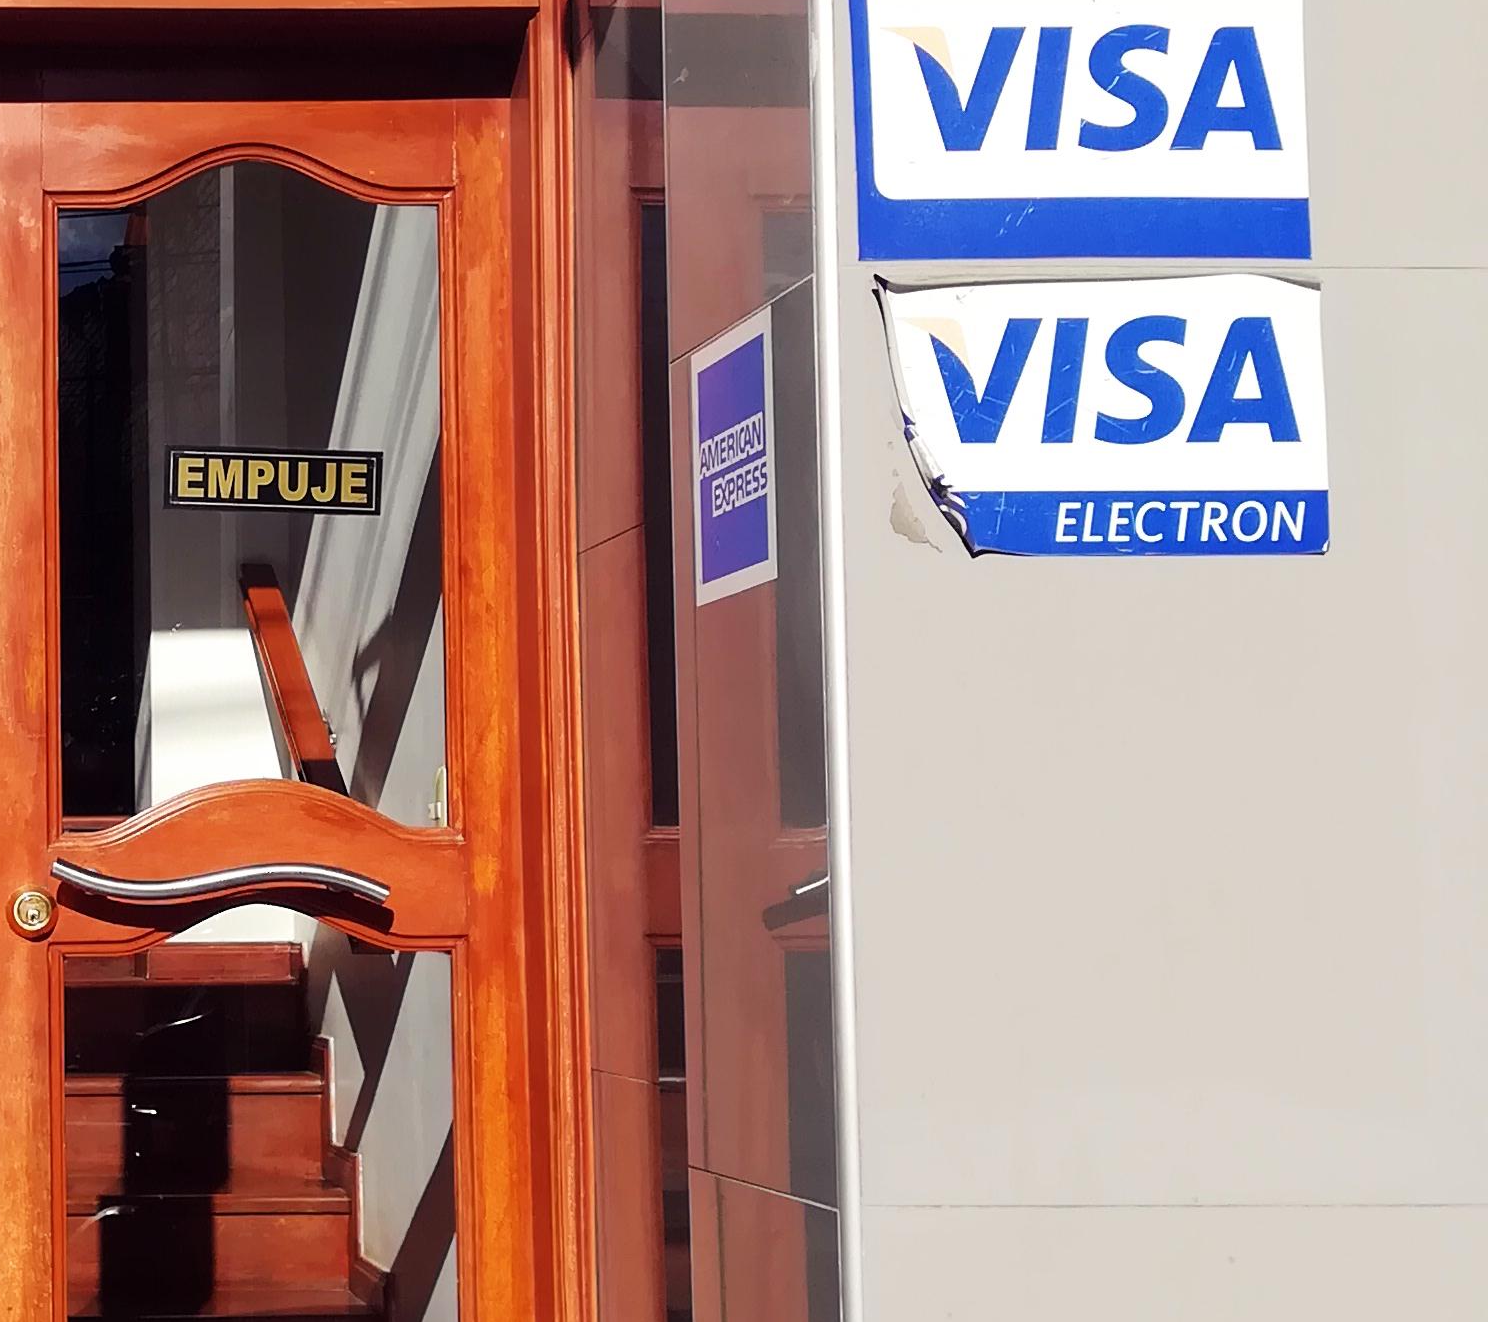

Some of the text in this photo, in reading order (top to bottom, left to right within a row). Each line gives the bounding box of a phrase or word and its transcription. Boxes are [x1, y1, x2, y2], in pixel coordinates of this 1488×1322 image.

[878, 23, 1284, 152] VISA
[900, 314, 1302, 445] VISA
[699, 417, 761, 475] AMERICAN
[177, 457, 368, 504] EMPUJE
[714, 461, 768, 511] EXPRESS
[1055, 501, 1306, 543] ELECTRON
